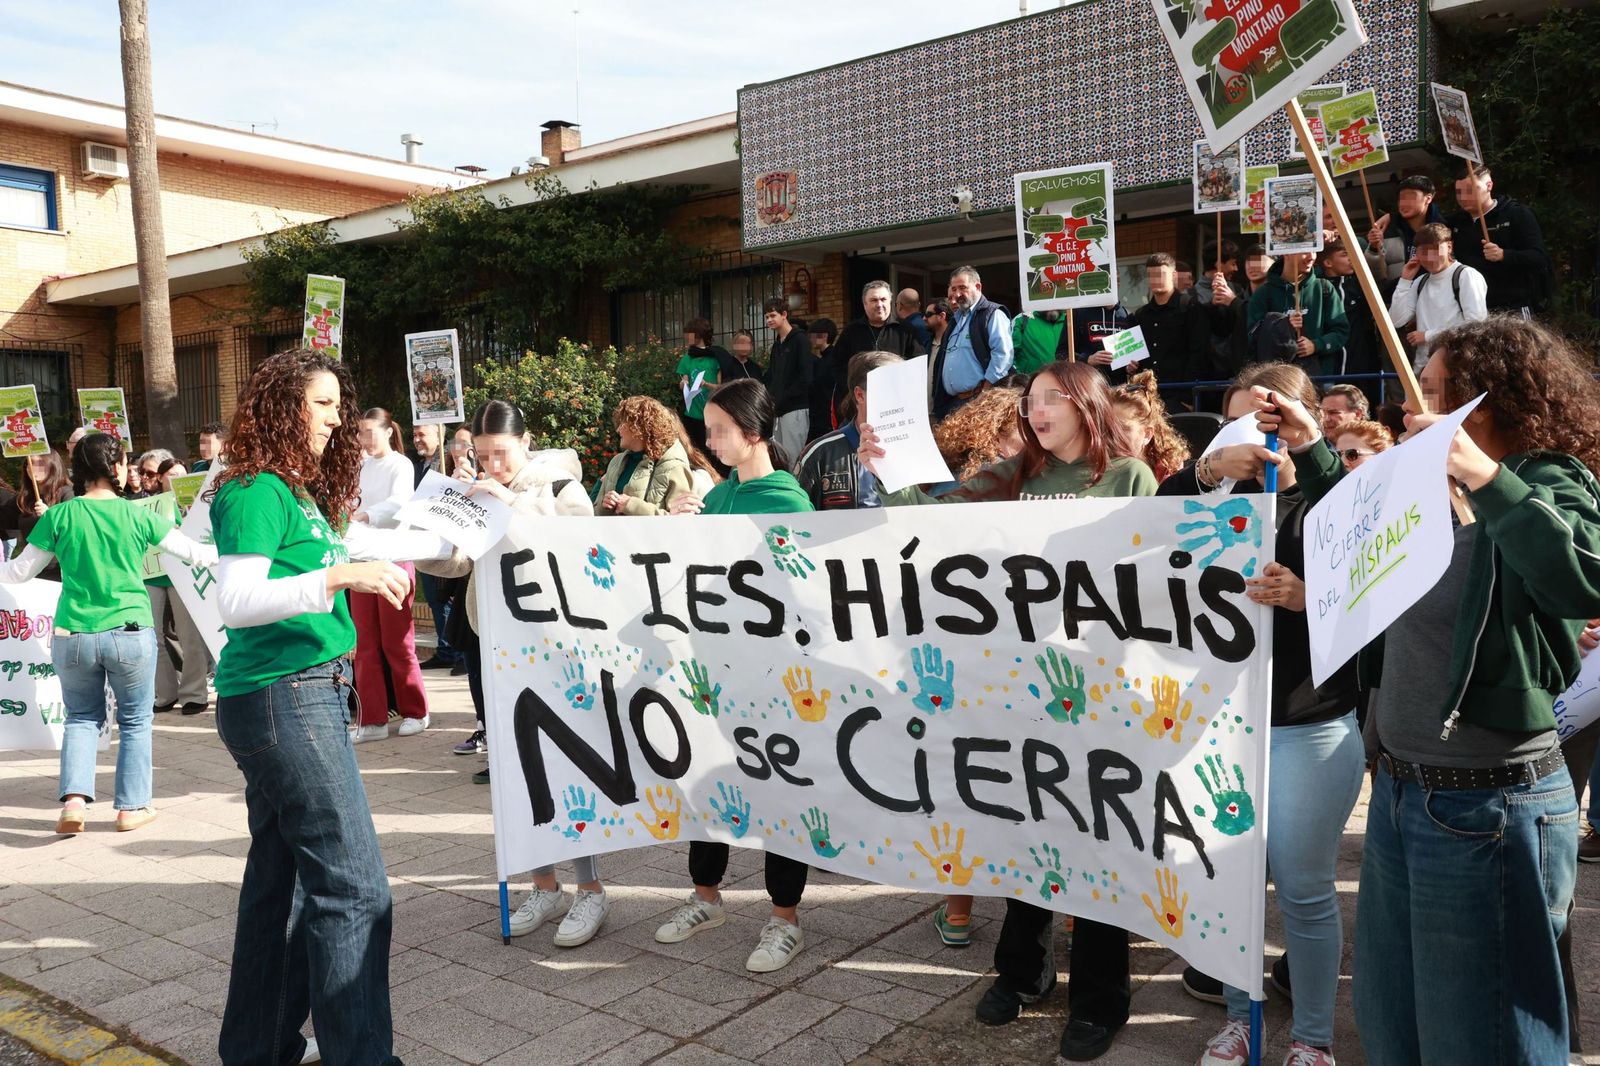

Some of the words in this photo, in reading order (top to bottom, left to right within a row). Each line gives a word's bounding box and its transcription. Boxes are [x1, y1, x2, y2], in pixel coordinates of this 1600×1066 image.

[1236, 0, 1263, 27] PINO
[1230, 4, 1286, 58] MONTANO
[1025, 172, 1101, 193] ¡SALVEMOS!
[1056, 243, 1065, 252] EL
[1060, 253, 1077, 262] PINO
[1053, 263, 1086, 275] MONTANO
[875, 422, 896, 432] STUDIAR
[440, 495, 477, 520] ESTUDIAR
[444, 487, 488, 518] QUEREMOS
[428, 505, 470, 529] HISPALIS!
[1312, 504, 1334, 559] NO
[1352, 476, 1382, 519] AL
[1330, 500, 1382, 570] CIERRE
[499, 548, 608, 630] EL
[1318, 587, 1341, 620] DEL
